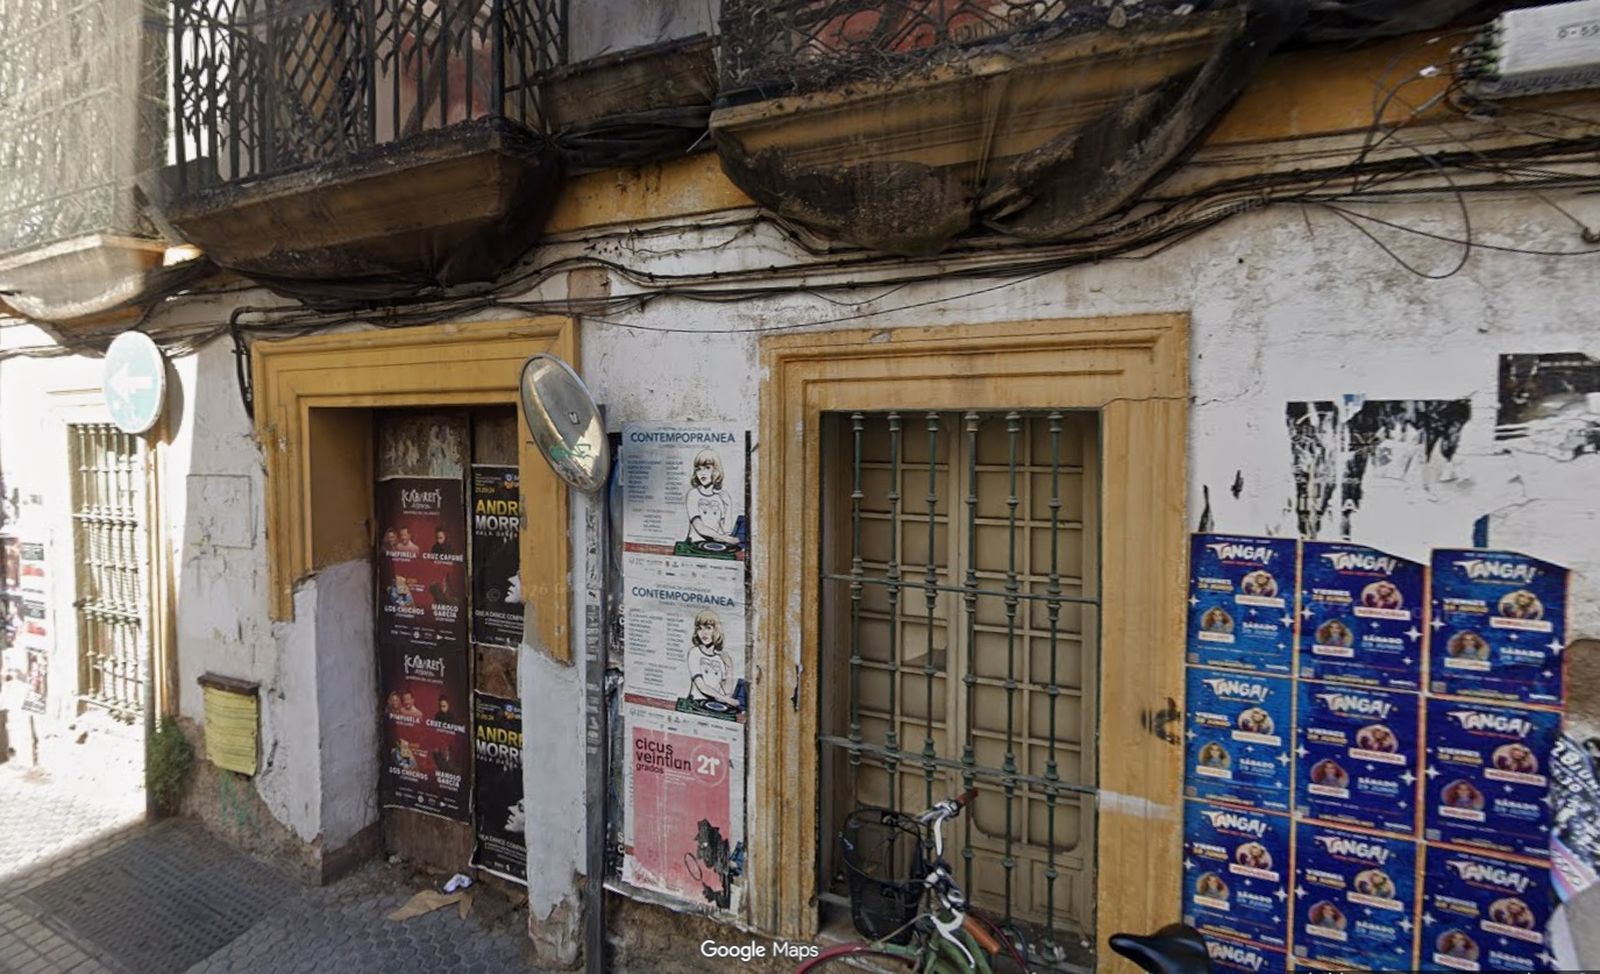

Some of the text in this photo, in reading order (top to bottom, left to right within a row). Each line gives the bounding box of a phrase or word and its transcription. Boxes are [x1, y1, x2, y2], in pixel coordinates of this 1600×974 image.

[630, 432, 736, 443] CONTEMPOPRANEA
[1205, 542, 1273, 565] TANGA!
[1320, 551, 1396, 575] TANGA!
[1452, 559, 1537, 584] TANGA!
[631, 586, 735, 608] CONTEMPOPRANEA
[1202, 677, 1269, 702] TANGA!
[1315, 692, 1392, 719] TANGA!
[1446, 710, 1534, 738] TANGA!
[635, 737, 674, 754] cicus
[635, 762, 665, 775] grados
[1201, 811, 1267, 838] TANGA!
[1314, 835, 1391, 865] TANGA!
[1446, 860, 1531, 893] TANGA!
